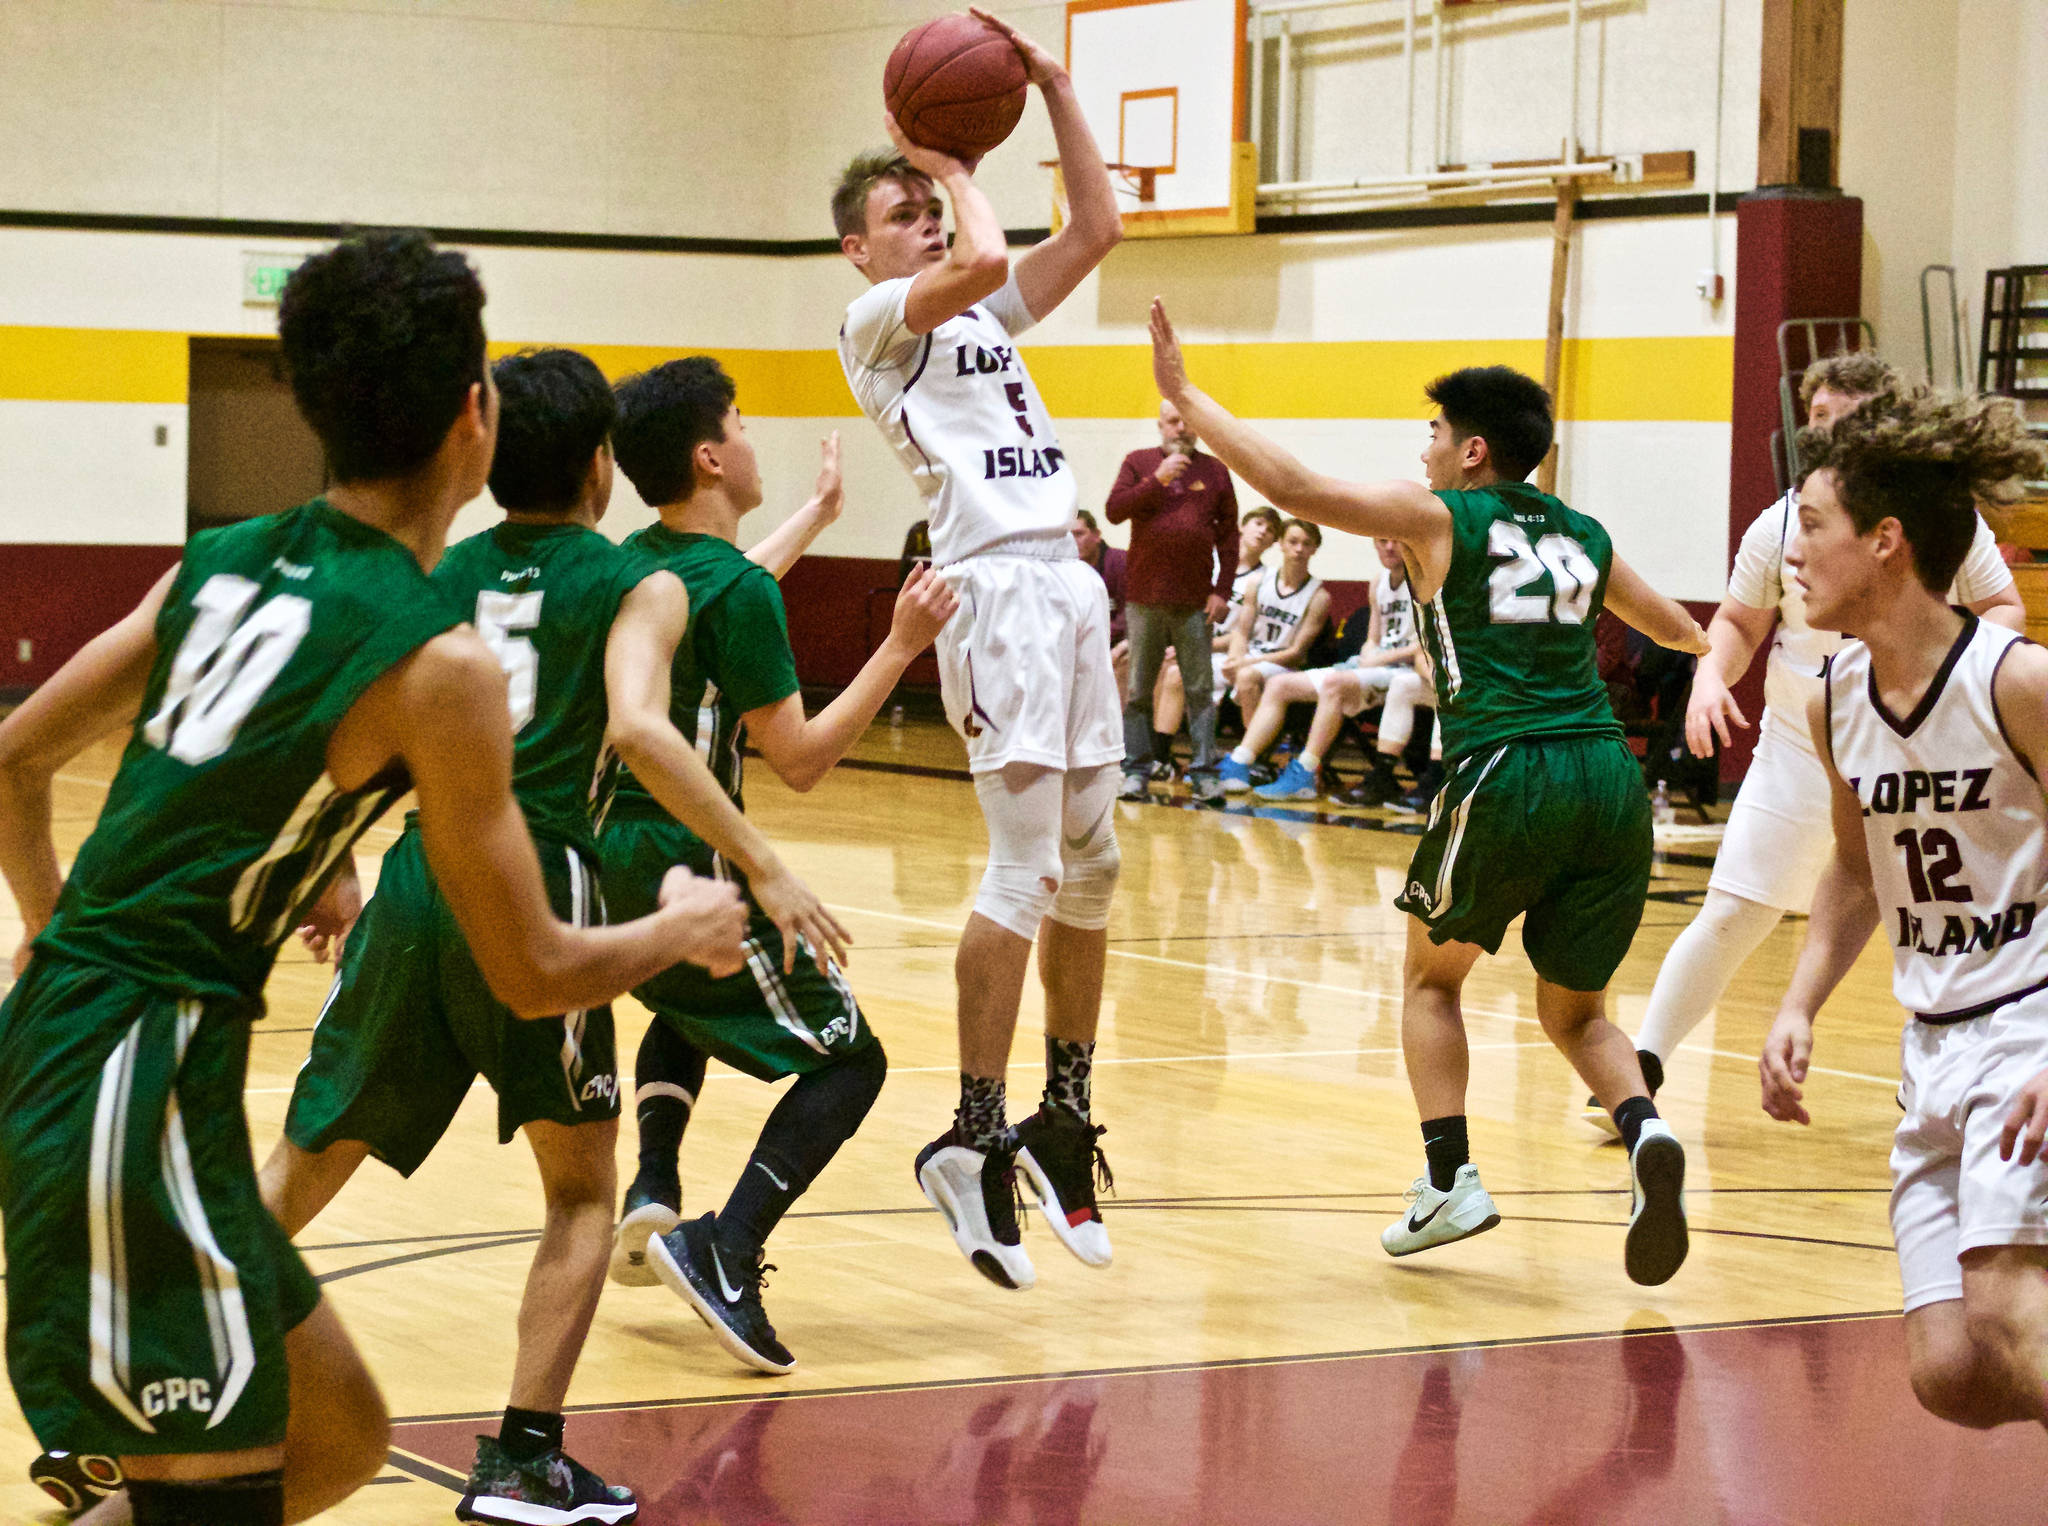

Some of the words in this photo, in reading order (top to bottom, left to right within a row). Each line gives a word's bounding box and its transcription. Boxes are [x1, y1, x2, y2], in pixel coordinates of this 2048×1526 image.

[1488, 519, 1599, 625] 20
[144, 573, 314, 767] 10
[475, 590, 545, 737] 5
[1894, 828, 1974, 903] 12
[1409, 880, 1432, 912] CPC
[820, 1016, 850, 1046] CPC
[581, 1074, 613, 1101] CPC
[142, 1376, 213, 1418] CPC
